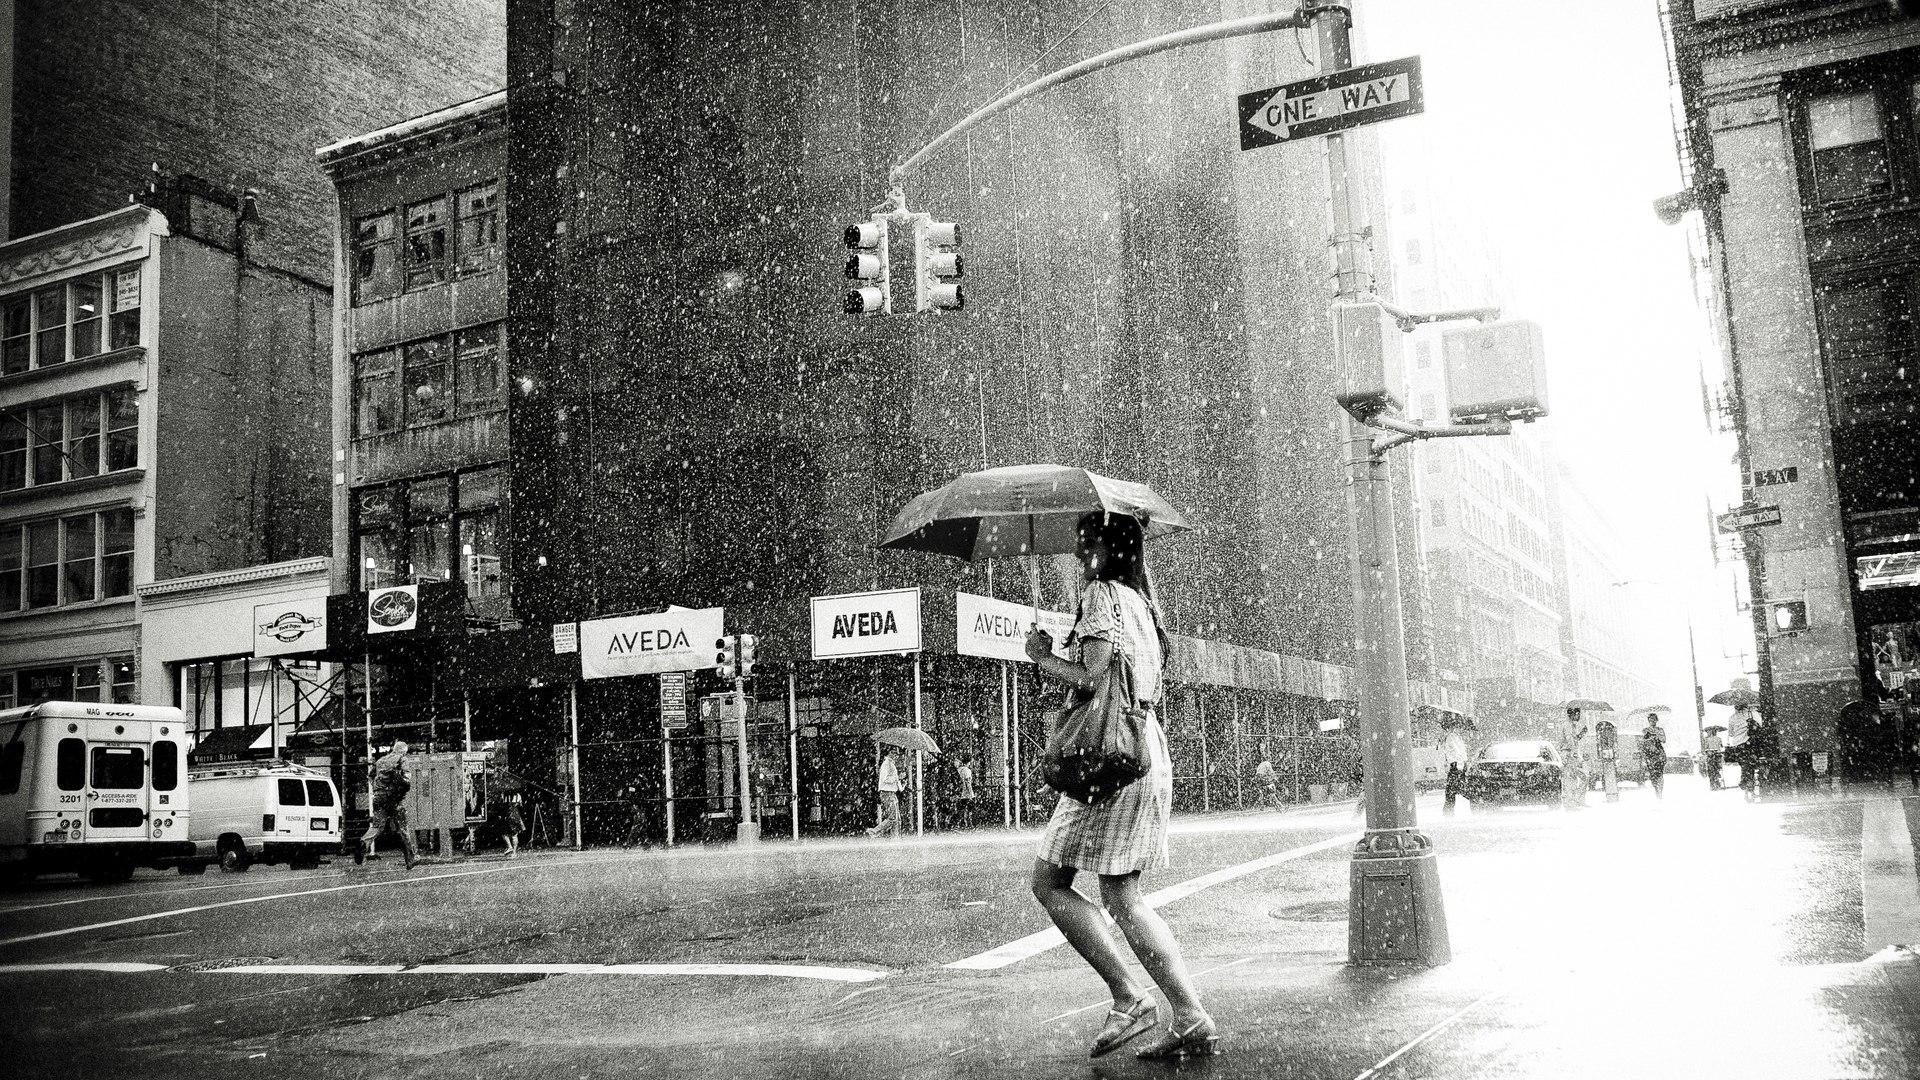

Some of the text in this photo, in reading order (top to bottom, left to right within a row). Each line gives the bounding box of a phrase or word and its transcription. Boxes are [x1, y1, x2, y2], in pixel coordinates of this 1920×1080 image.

[1266, 78, 1397, 127] ONE WAY
[1776, 470, 1789, 483] AV
[831, 610, 898, 639] AVEDA
[974, 612, 1022, 639] AVEDA
[607, 627, 691, 655] AVEDA
[86, 708, 100, 716] MAG
[60, 794, 81, 803] 3201
